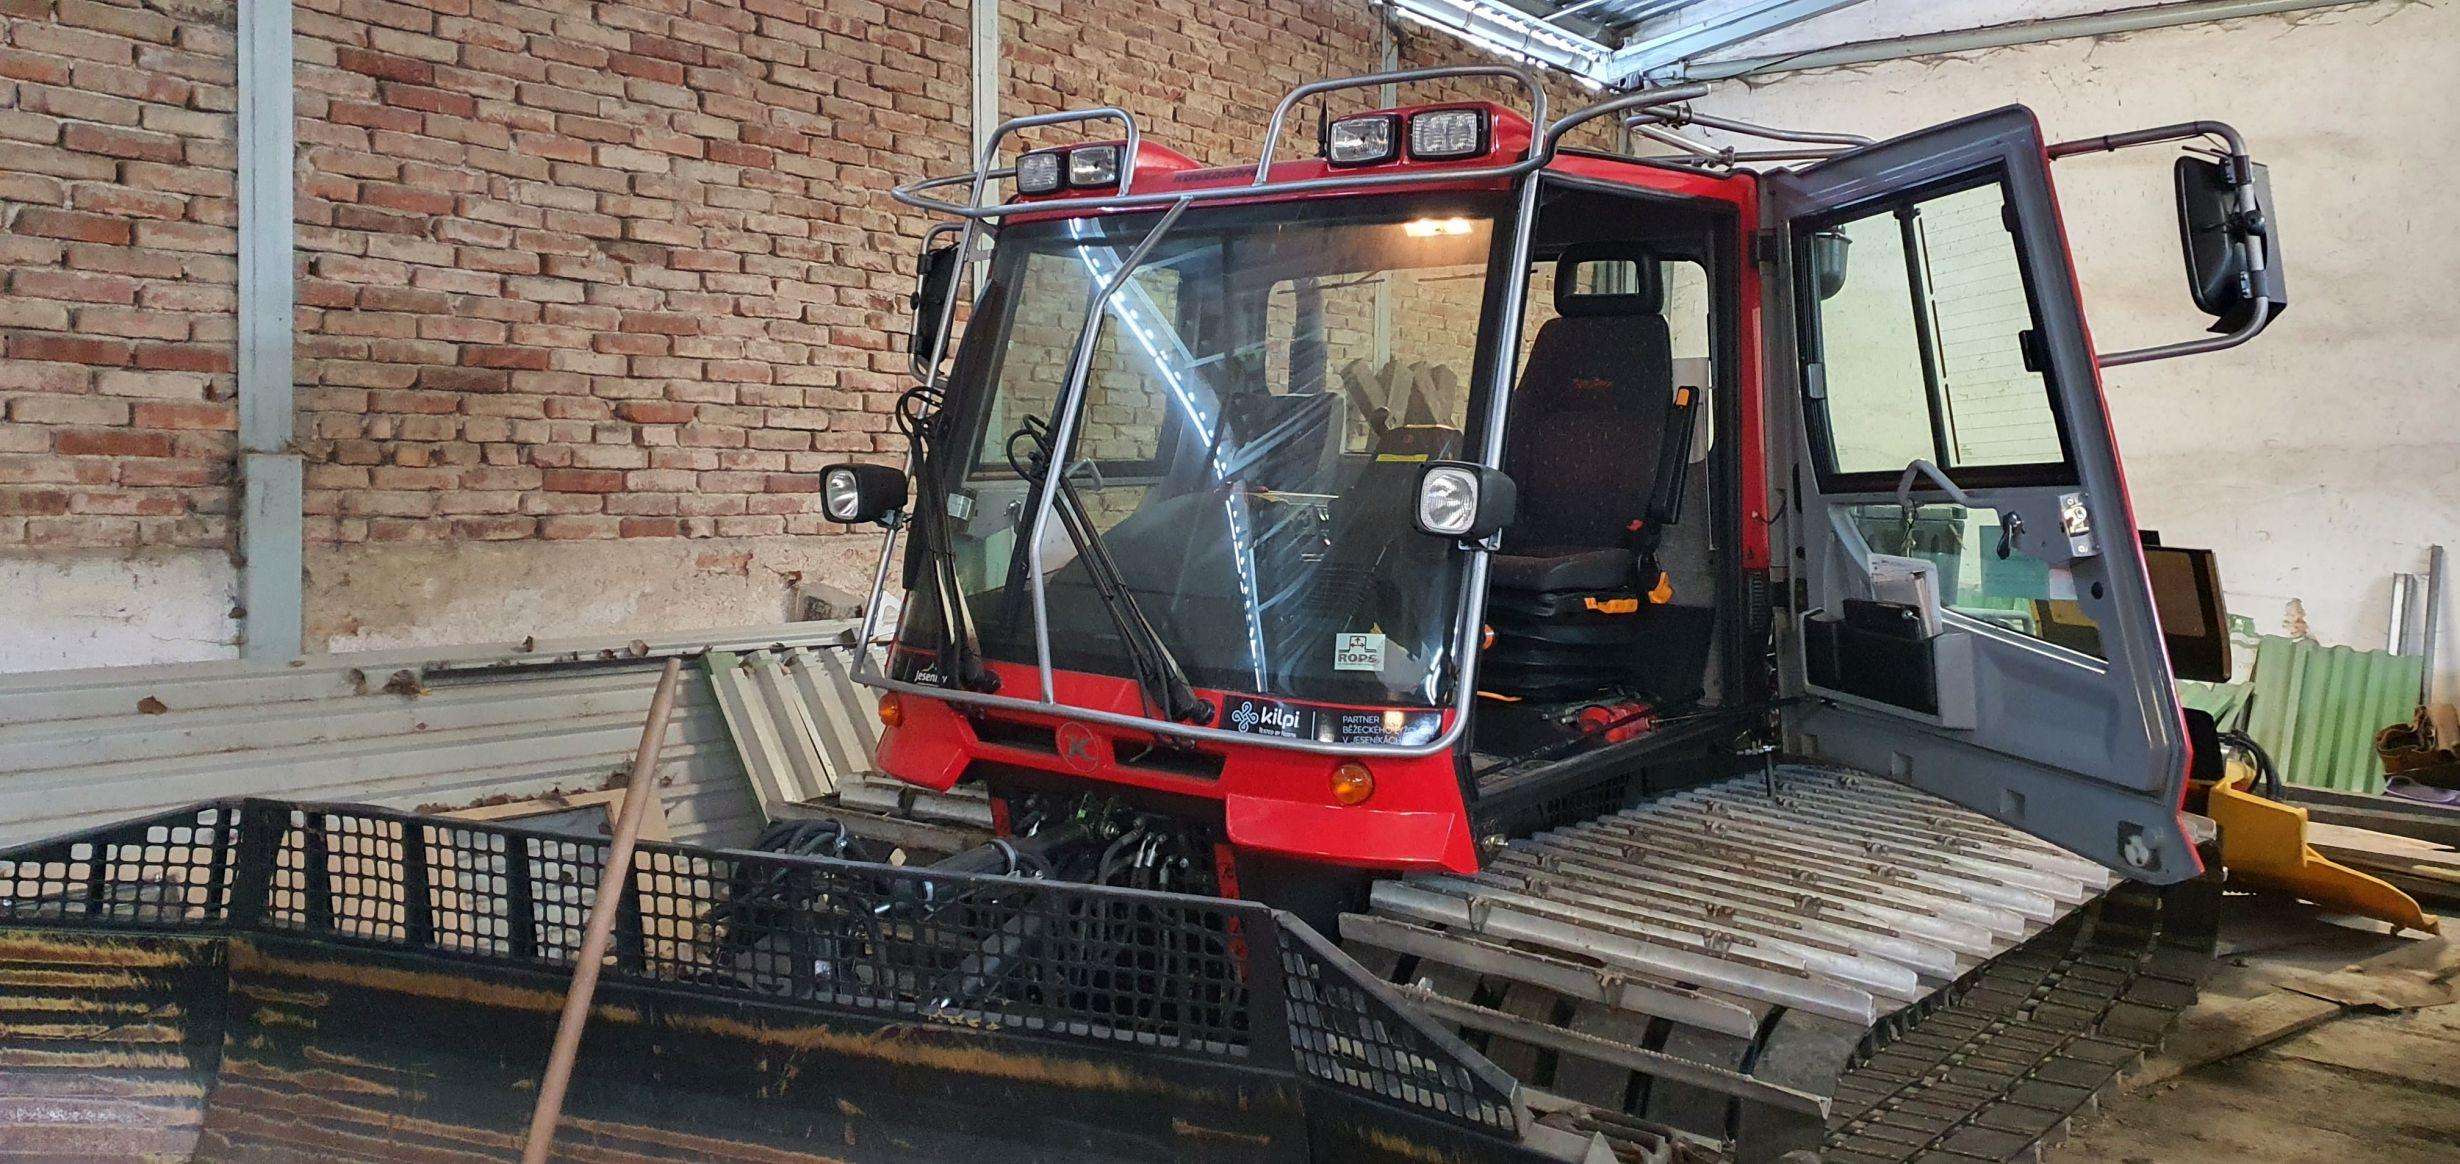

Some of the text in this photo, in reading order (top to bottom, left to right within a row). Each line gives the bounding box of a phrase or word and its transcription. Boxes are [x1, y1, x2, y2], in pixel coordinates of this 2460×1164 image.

[1337, 653, 1378, 664] ROPS
[1260, 706, 1300, 730] kilpi
[1342, 715, 1380, 725] PARTNER
